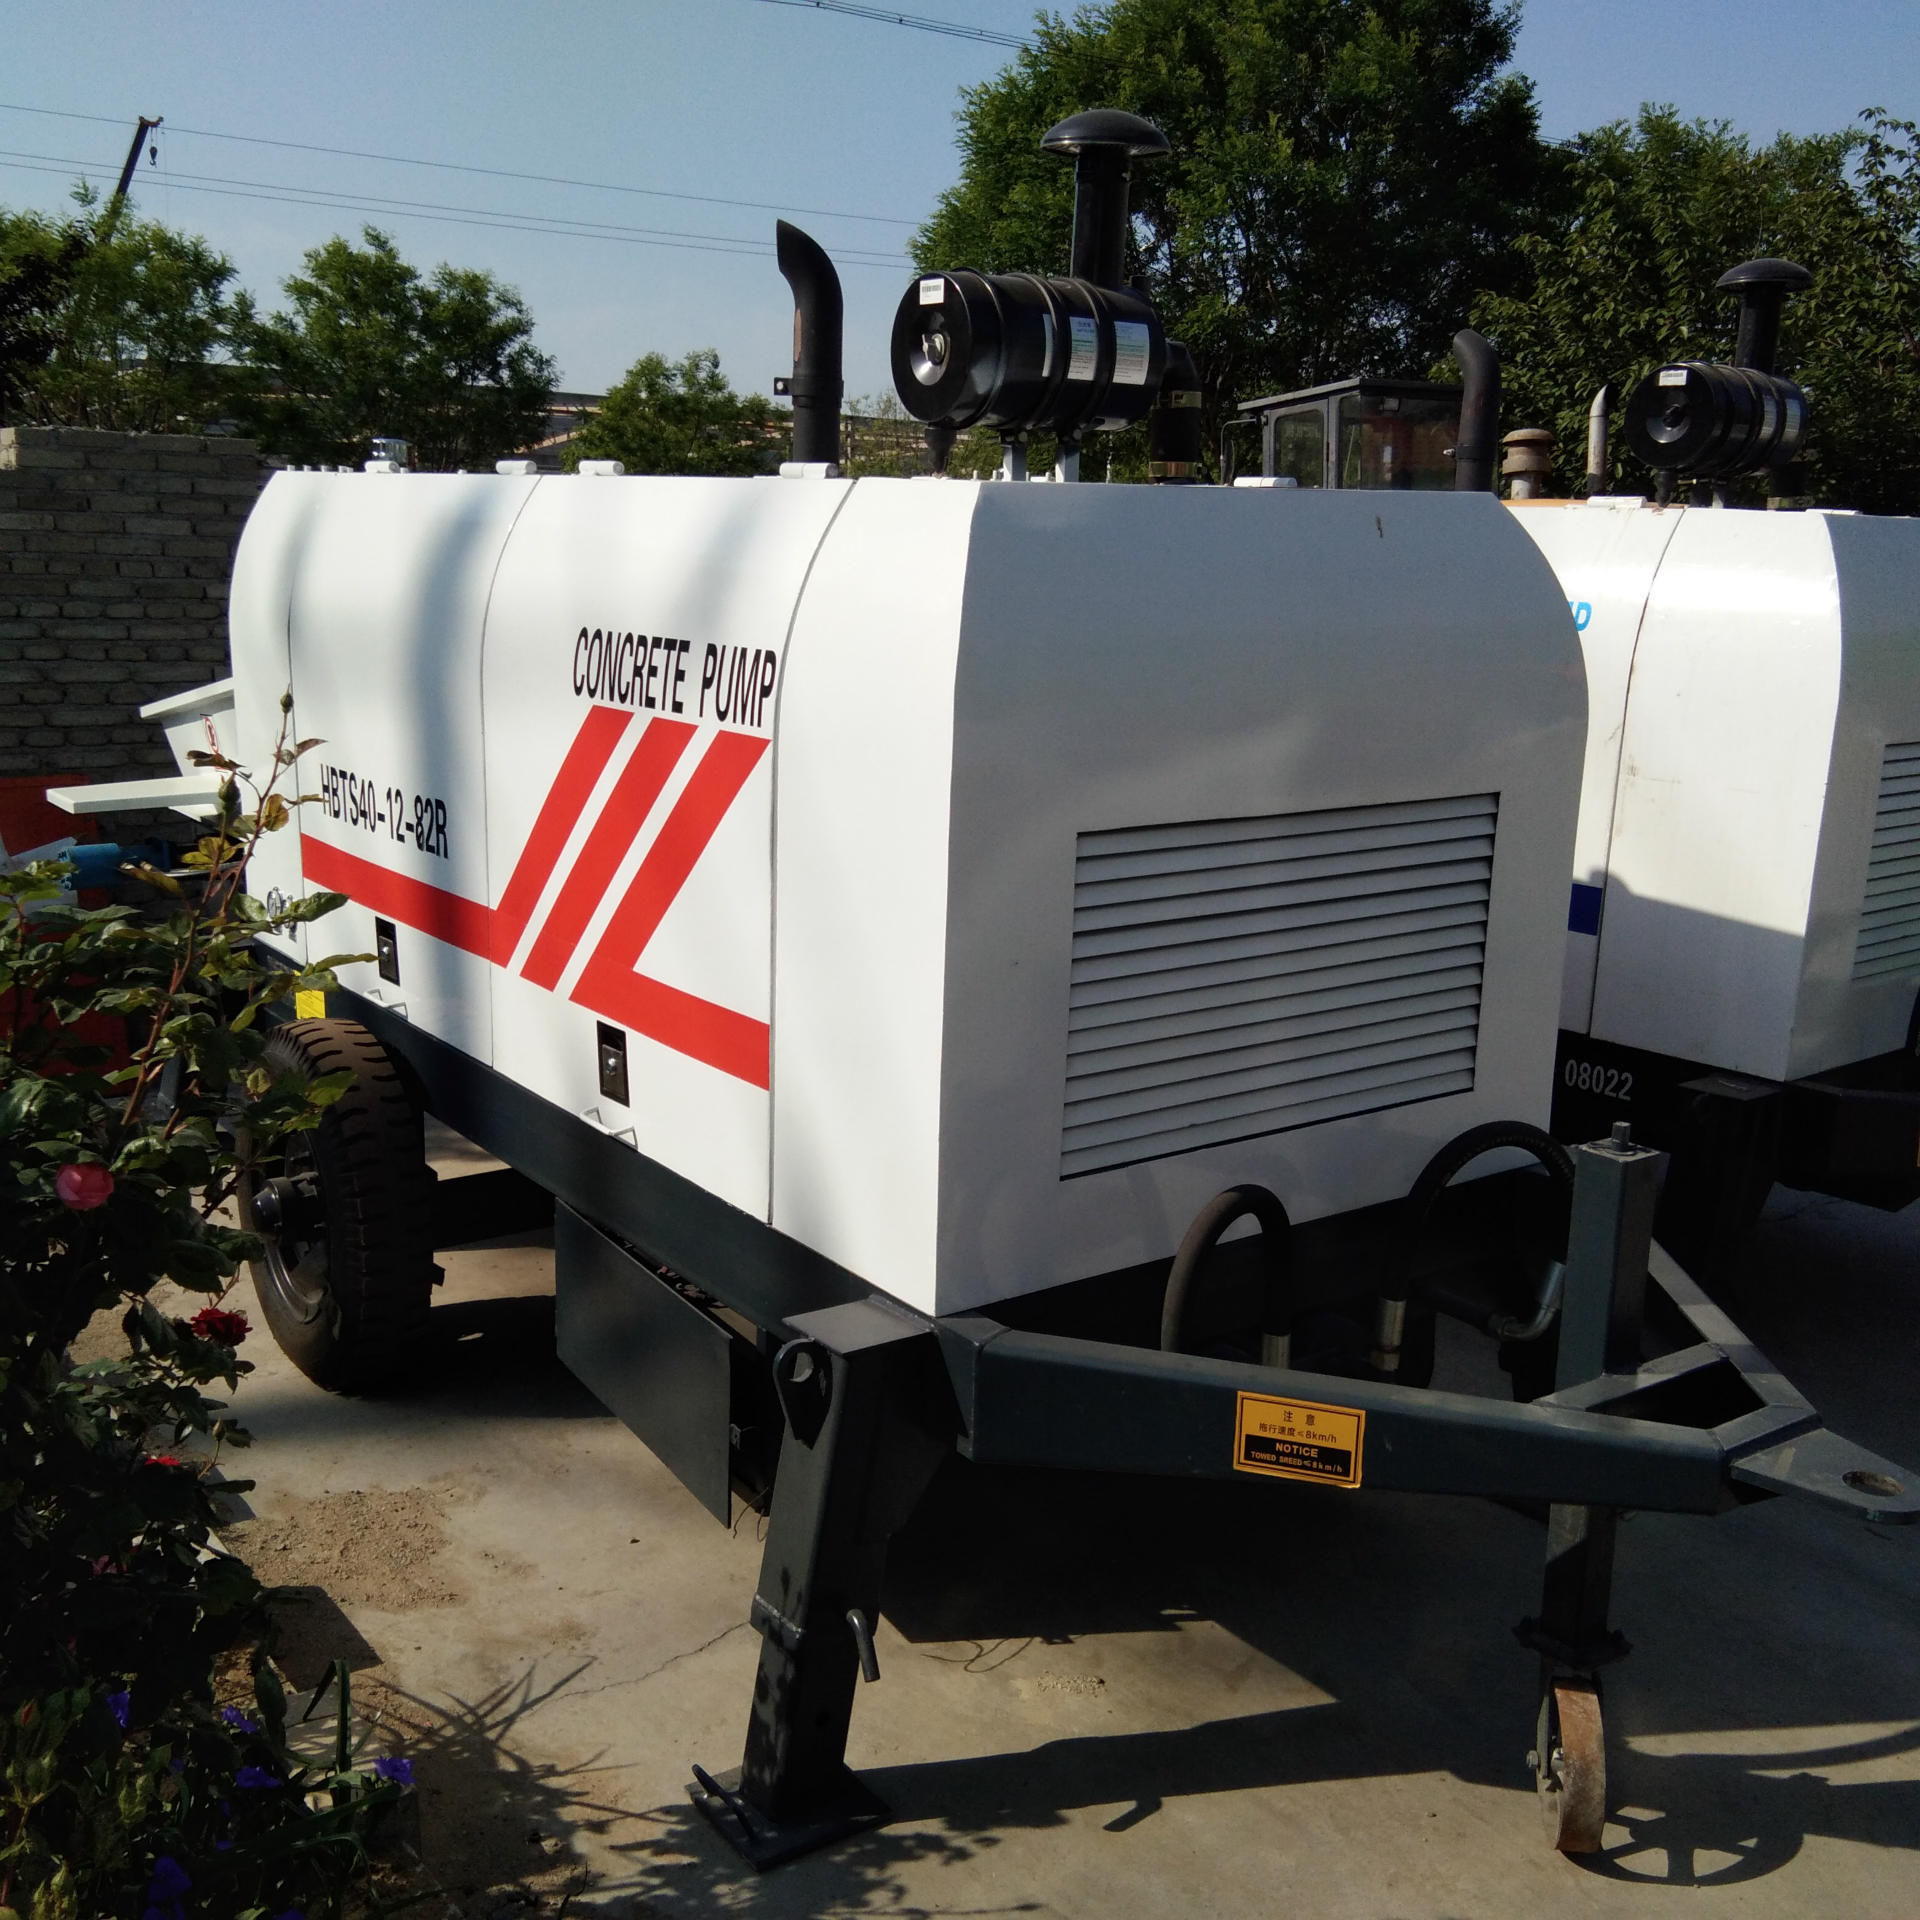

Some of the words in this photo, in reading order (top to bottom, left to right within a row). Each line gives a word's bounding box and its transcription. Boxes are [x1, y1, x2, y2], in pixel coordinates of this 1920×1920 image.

[573, 626, 691, 714] CONCRETE
[699, 643, 777, 728] PUMP
[320, 763, 448, 859] HBTS40-12-82R
[1565, 1059, 1633, 1101] 08022
[1250, 1451, 1276, 1462] TOWED
[1275, 1442, 1319, 1458] NOTICE
